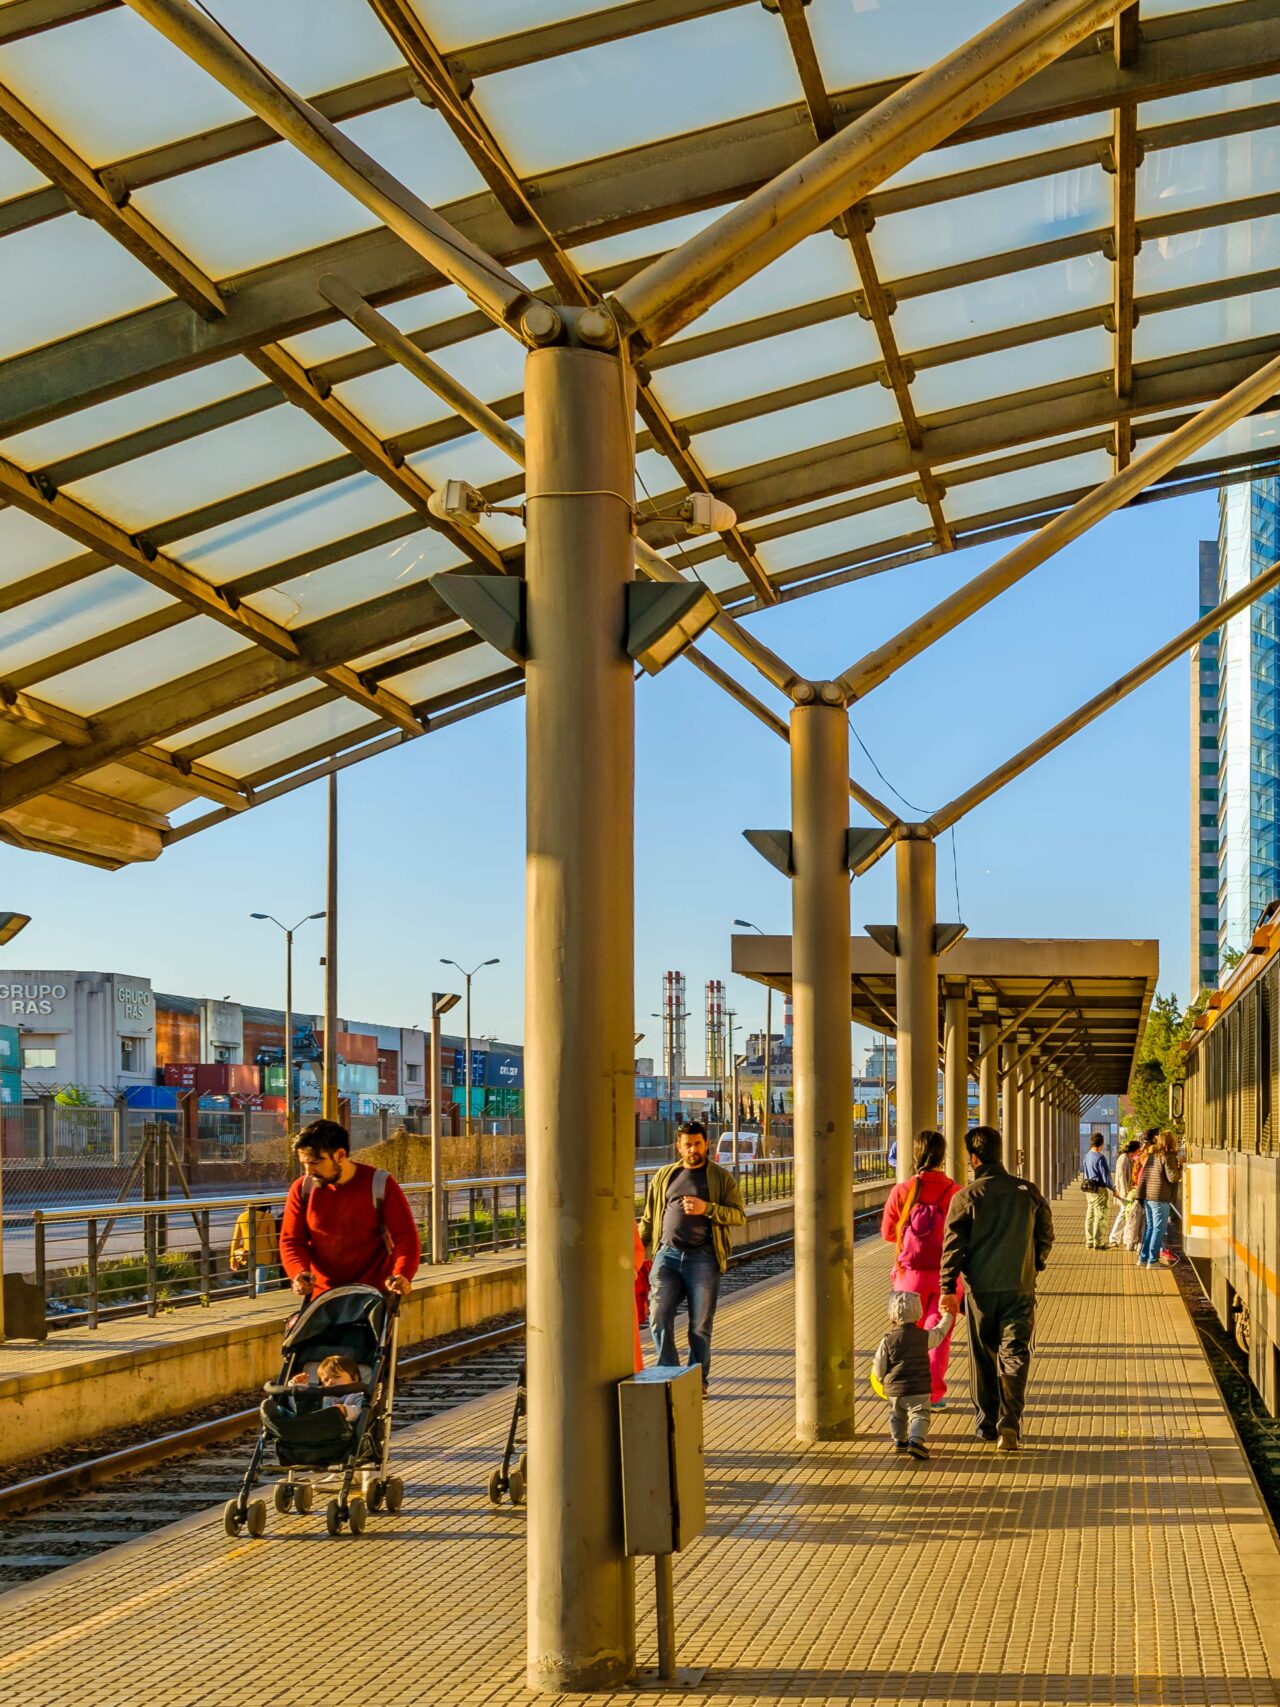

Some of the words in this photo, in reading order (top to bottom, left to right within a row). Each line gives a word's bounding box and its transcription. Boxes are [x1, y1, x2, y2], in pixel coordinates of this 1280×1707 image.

[0, 984, 67, 1000] GRUPO
[117, 987, 150, 1006] GRUPO
[11, 1000, 53, 1015] RAS
[125, 1004, 144, 1020] RAS
